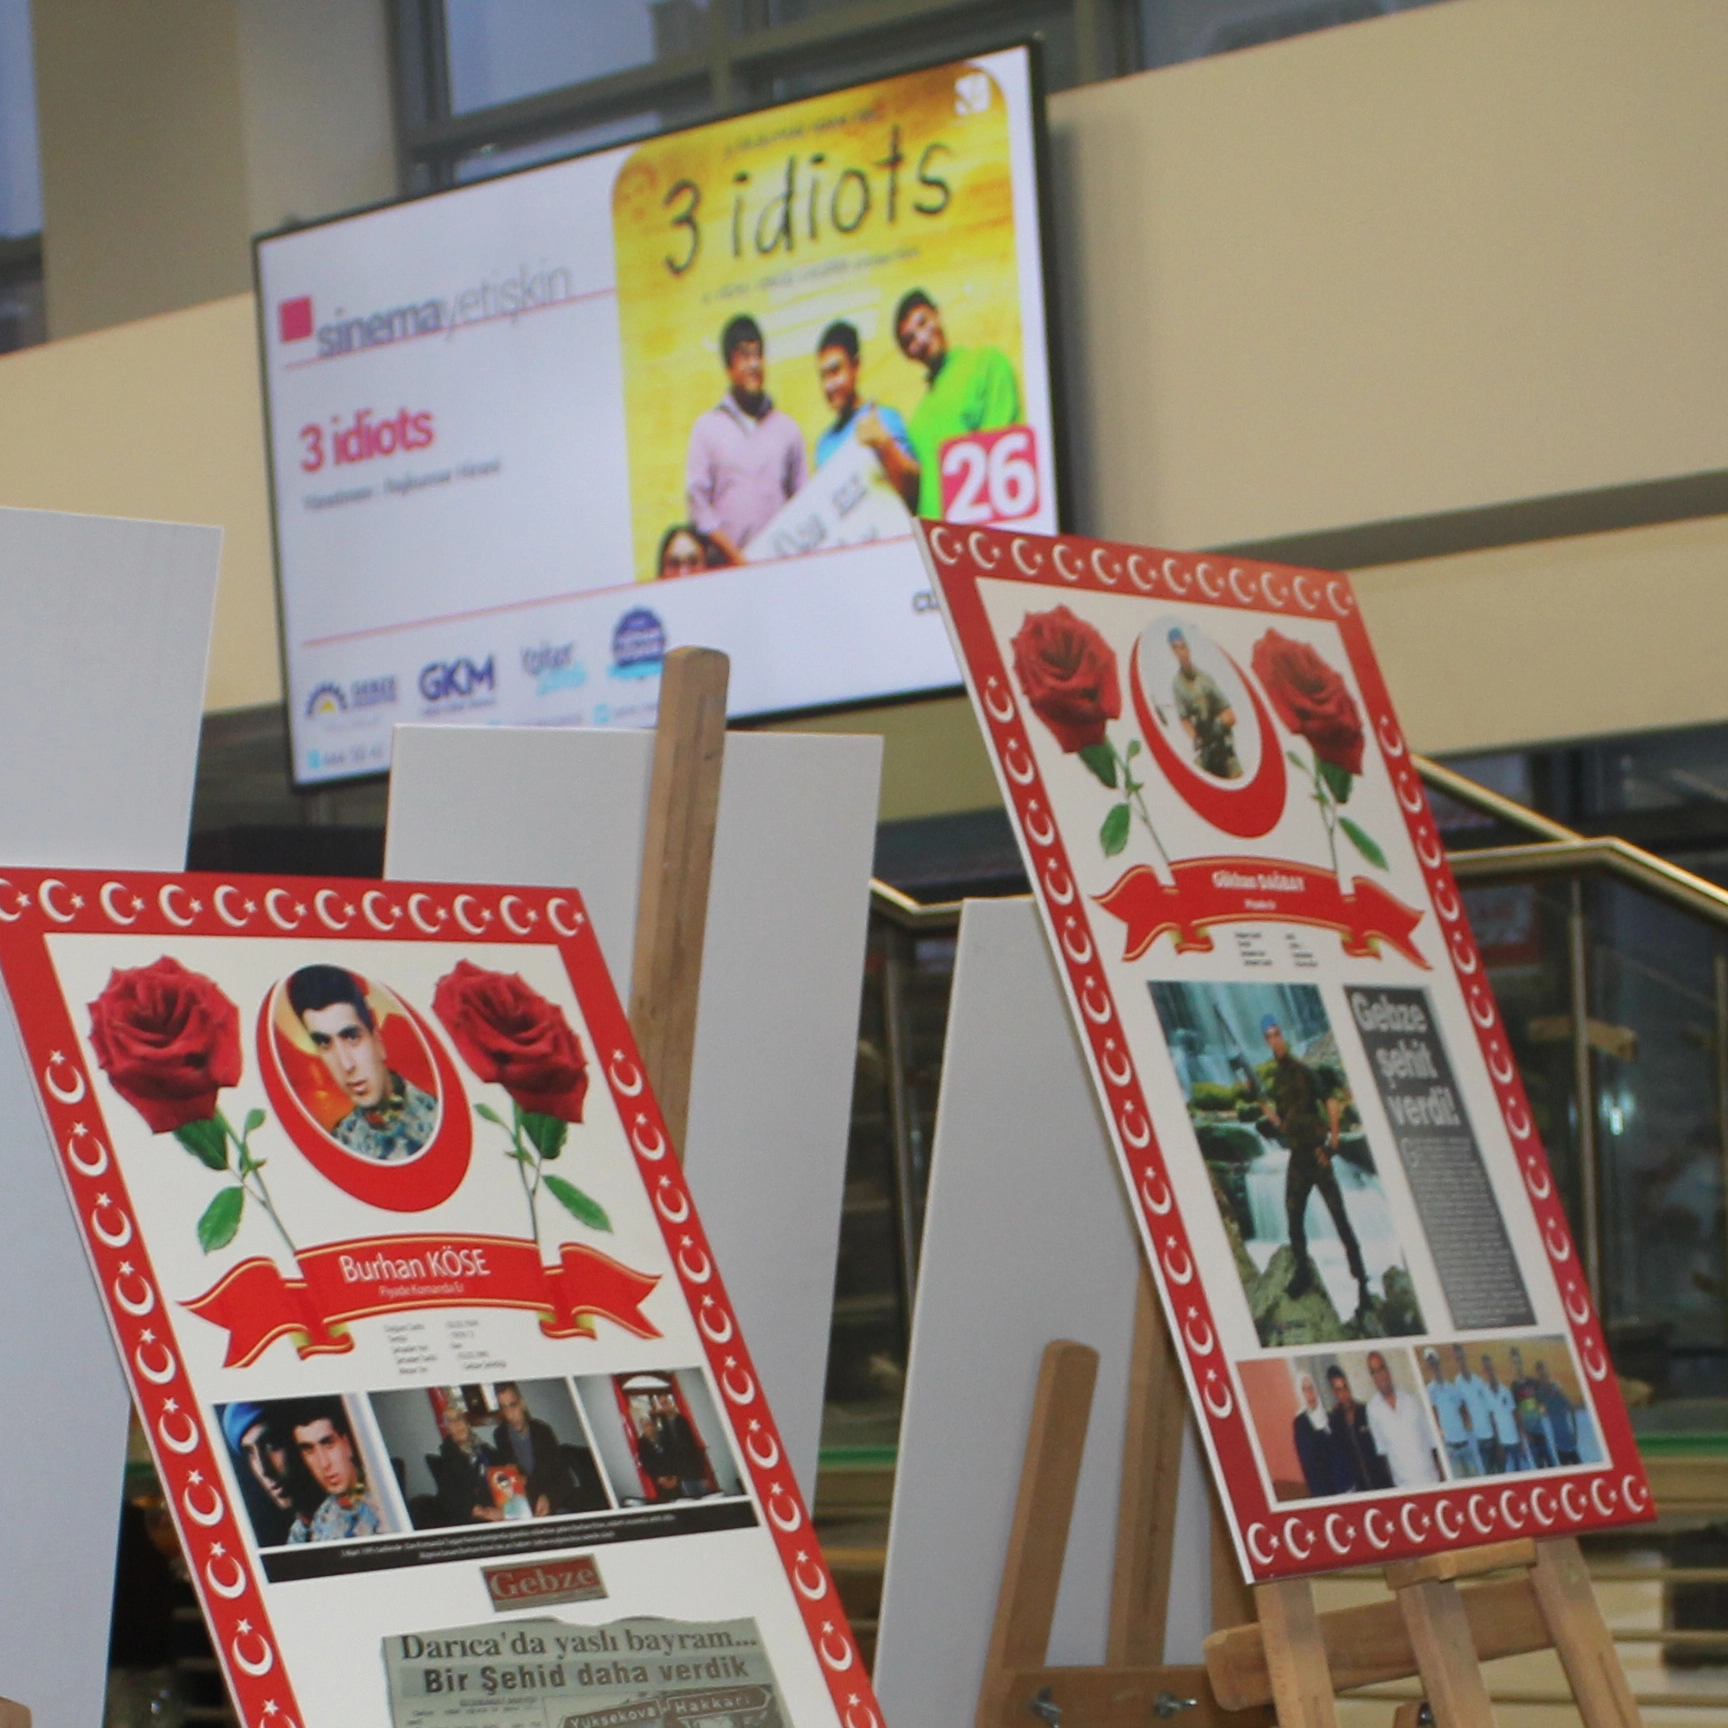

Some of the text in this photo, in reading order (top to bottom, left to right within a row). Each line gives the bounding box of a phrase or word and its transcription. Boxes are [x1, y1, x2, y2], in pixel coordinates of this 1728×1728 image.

[663, 178, 700, 277] 3
[731, 123, 956, 258] idiots
[300, 406, 434, 474] 3 idiots
[942, 430, 1039, 524] 26
[419, 653, 497, 701] GKM
[338, 1245, 491, 1283] Burhan KÖSE
[490, 1561, 598, 1600] Gebze
[401, 1628, 757, 1660] Darıca'da yaslı bayram...
[424, 1656, 751, 1695] Bir Şehid daha verdik
